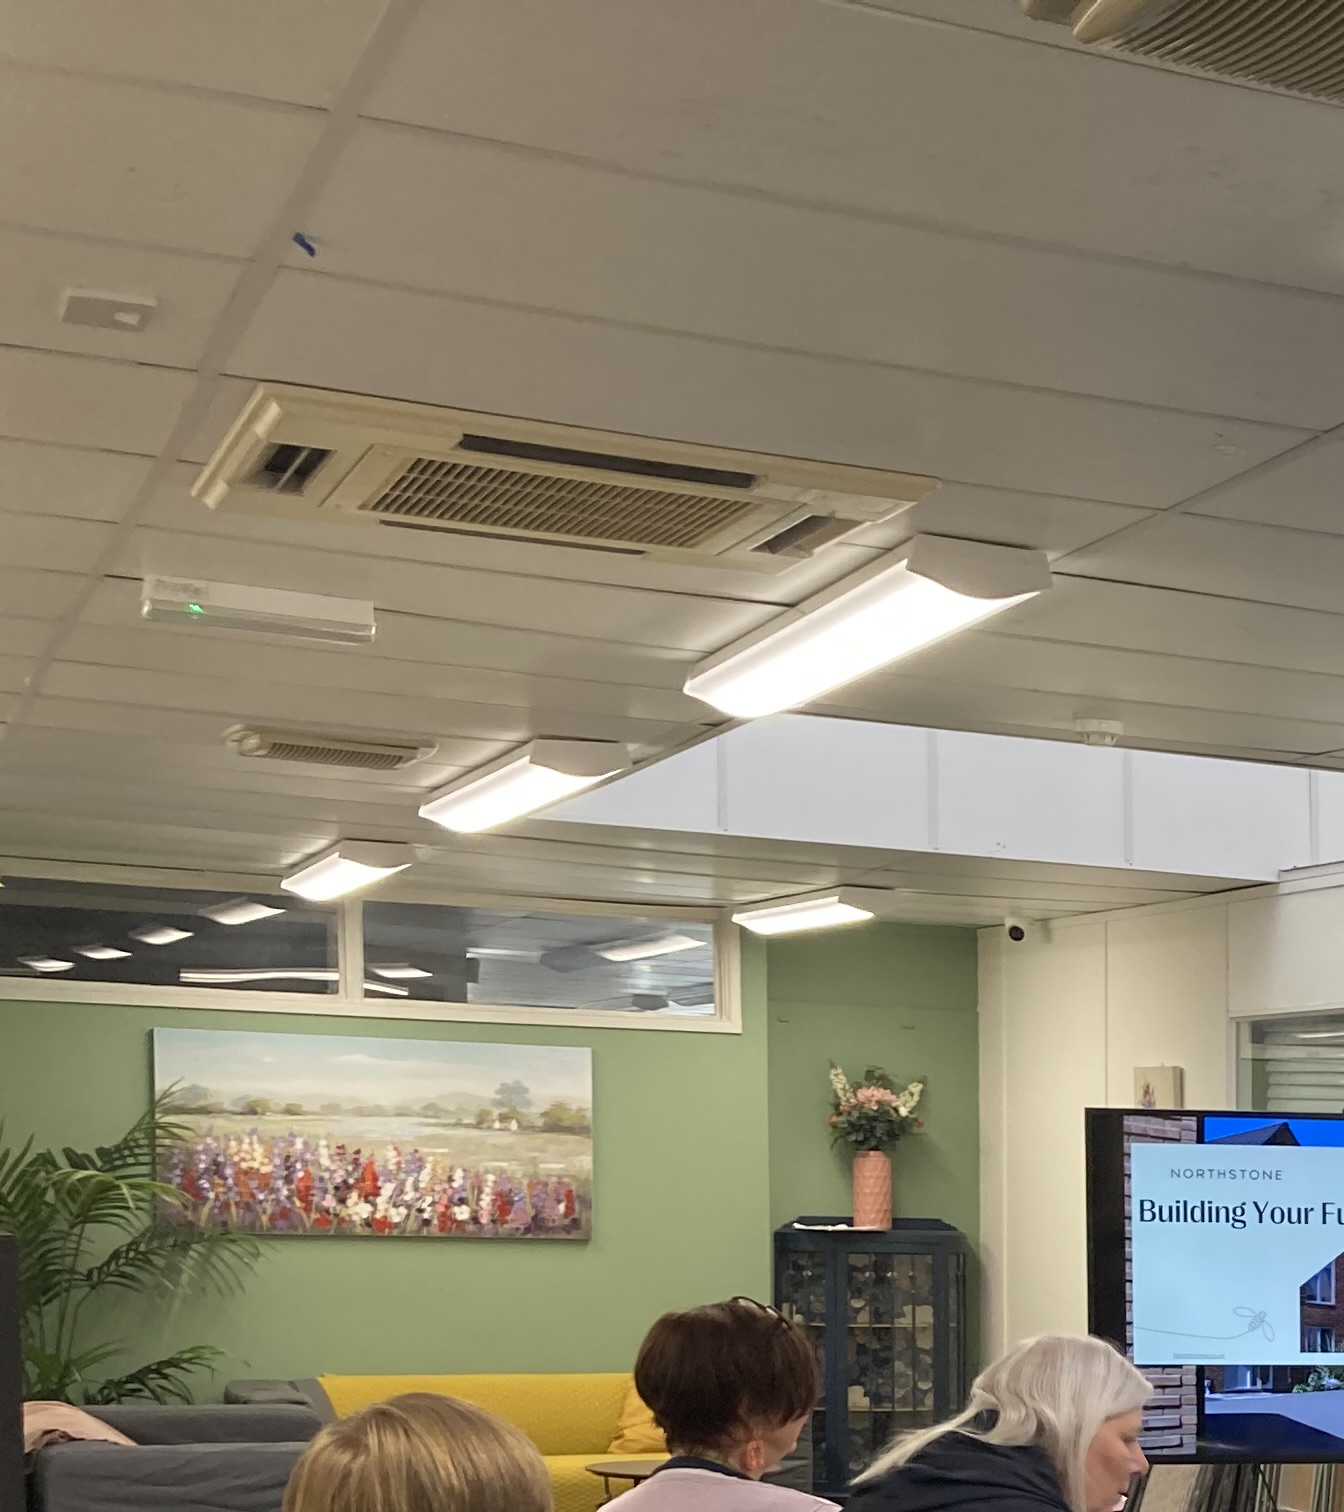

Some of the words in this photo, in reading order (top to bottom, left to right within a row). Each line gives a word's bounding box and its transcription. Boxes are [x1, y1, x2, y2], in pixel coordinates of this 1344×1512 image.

[1170, 1167, 1283, 1181] NORTHSTONE
[1138, 1198, 1247, 1230] Building
[1252, 1201, 1315, 1226] Your
